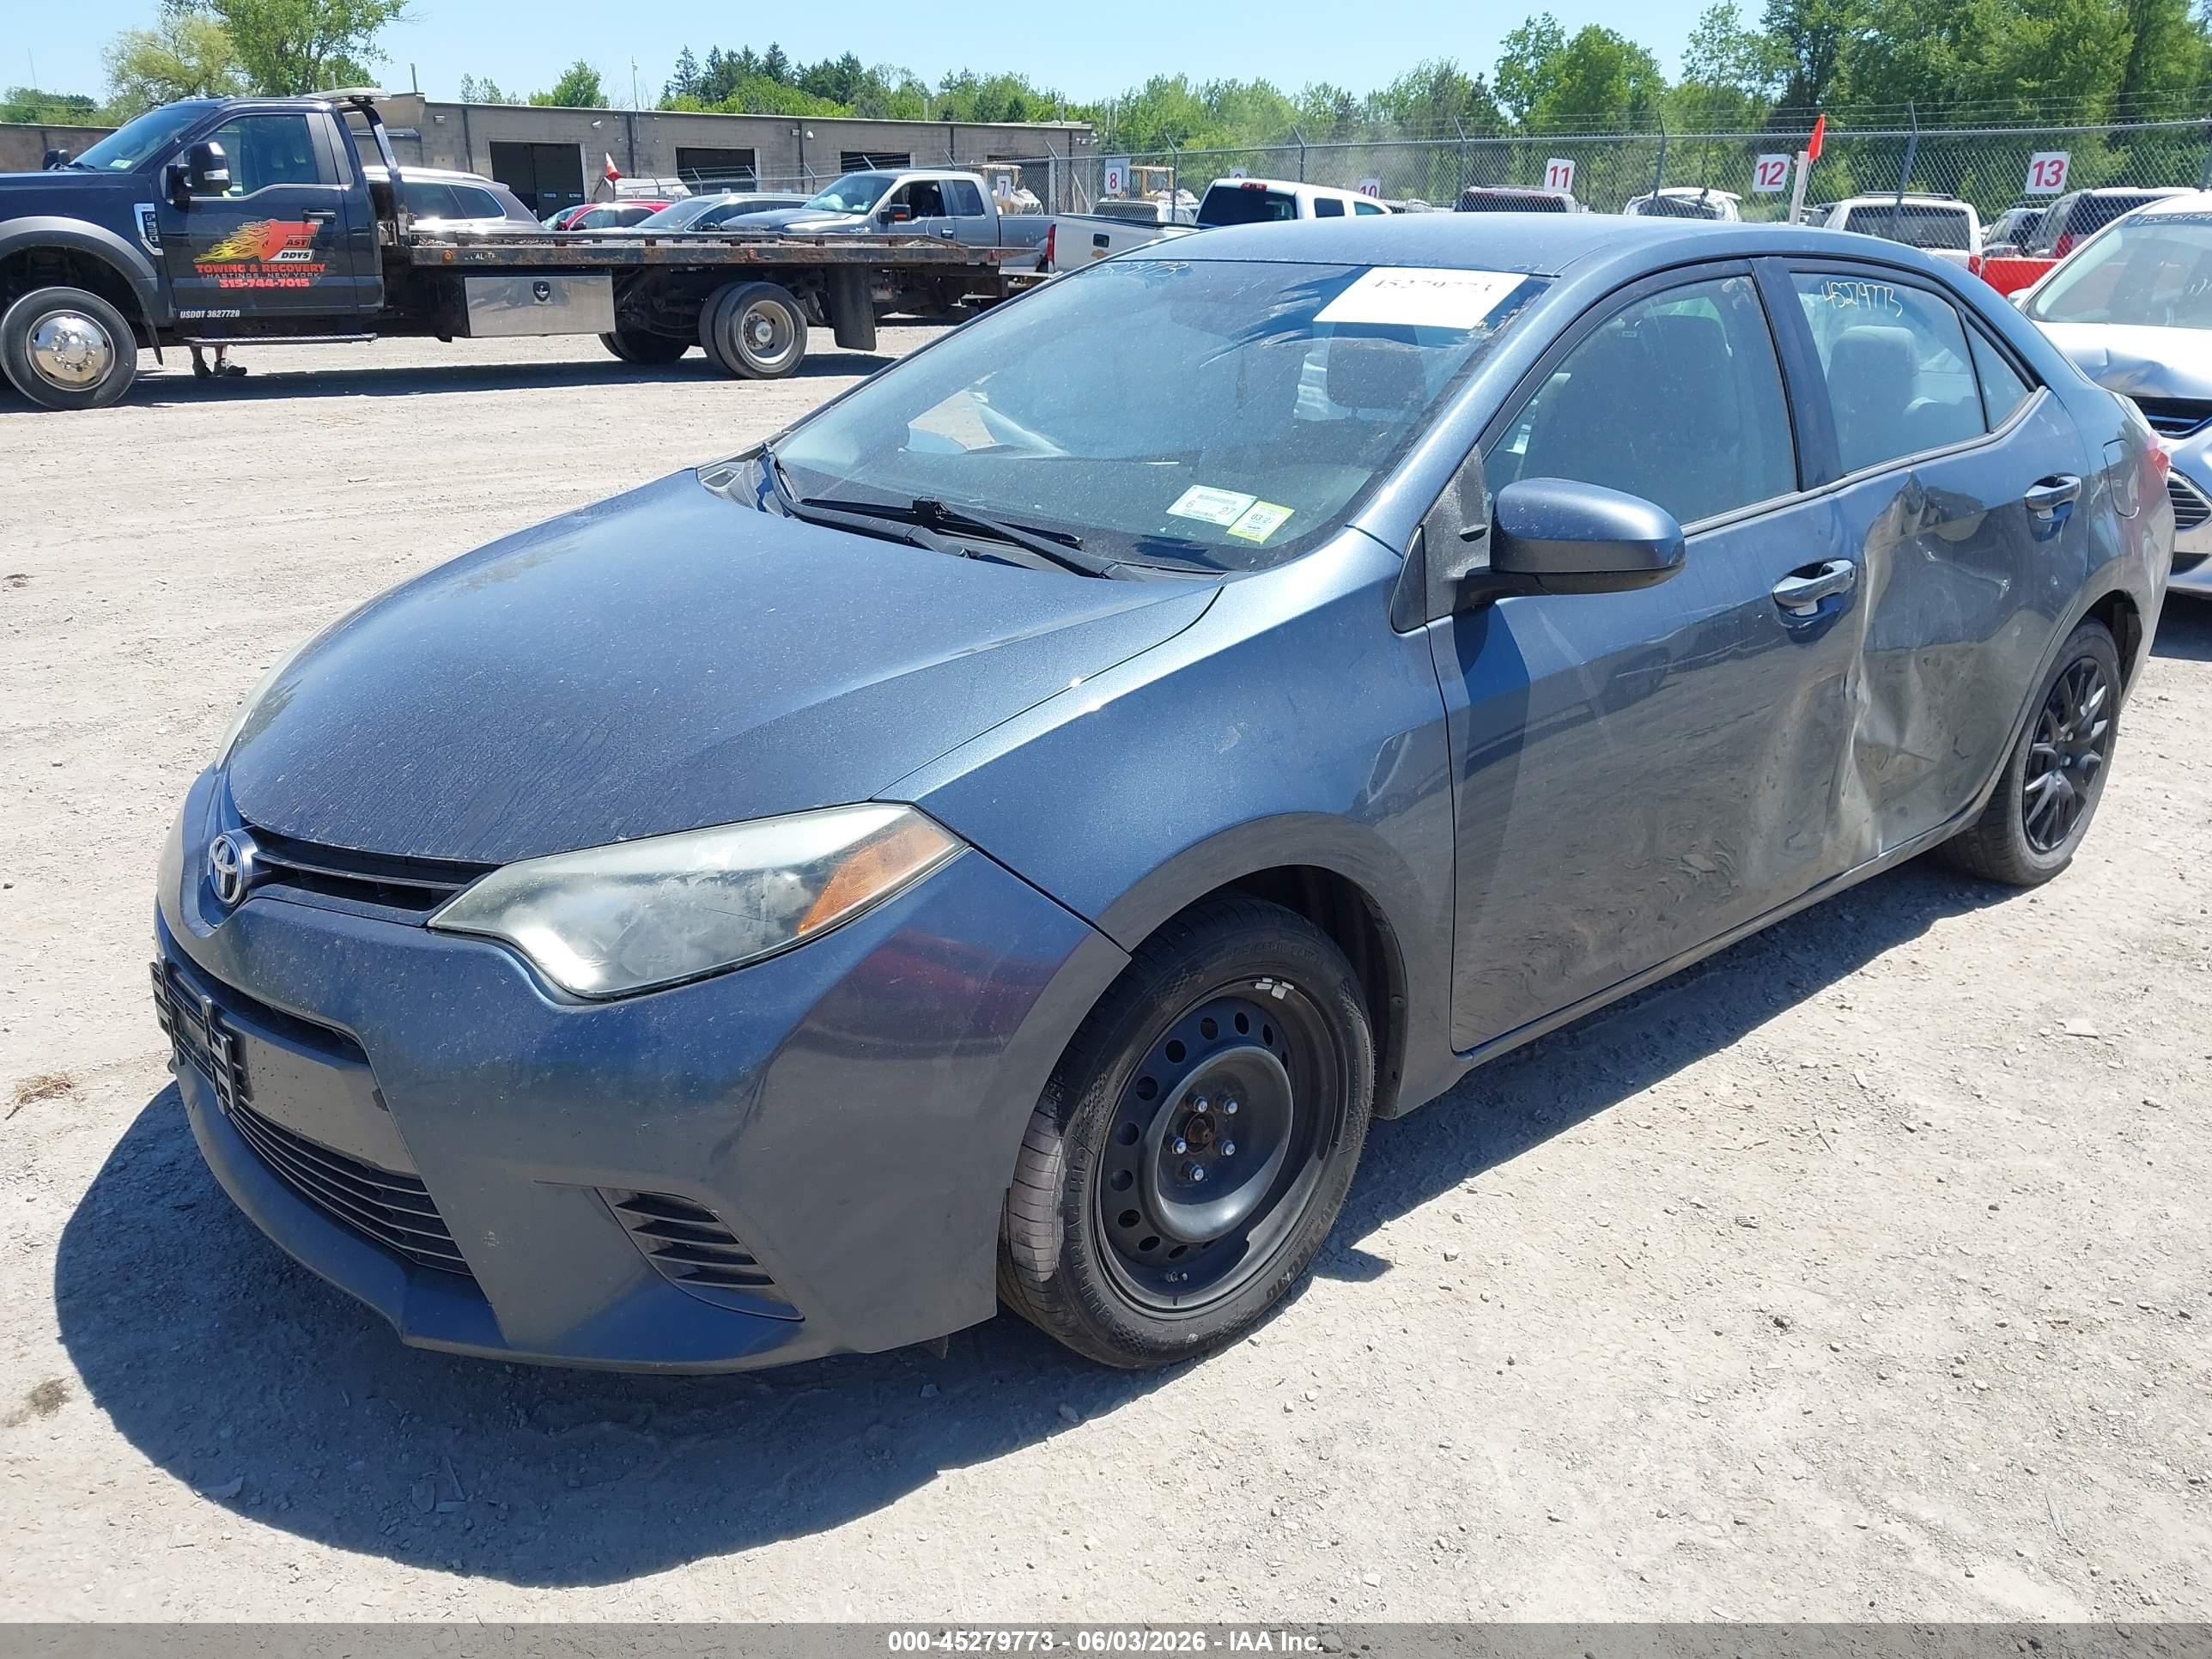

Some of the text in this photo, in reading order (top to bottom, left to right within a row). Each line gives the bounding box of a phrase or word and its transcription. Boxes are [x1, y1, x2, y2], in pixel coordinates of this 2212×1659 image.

[1109, 172, 1118, 189] 8
[1549, 165, 1571, 188] 11
[1758, 161, 1786, 185] 12
[2033, 159, 2065, 187] 13
[1000, 180, 1007, 197] 7
[195, 264, 325, 273] TOWING & RECOVERY
[219, 278, 310, 288] 315-744-7015
[1820, 281, 1903, 318] 45279773
[179, 310, 206, 319] USDOT
